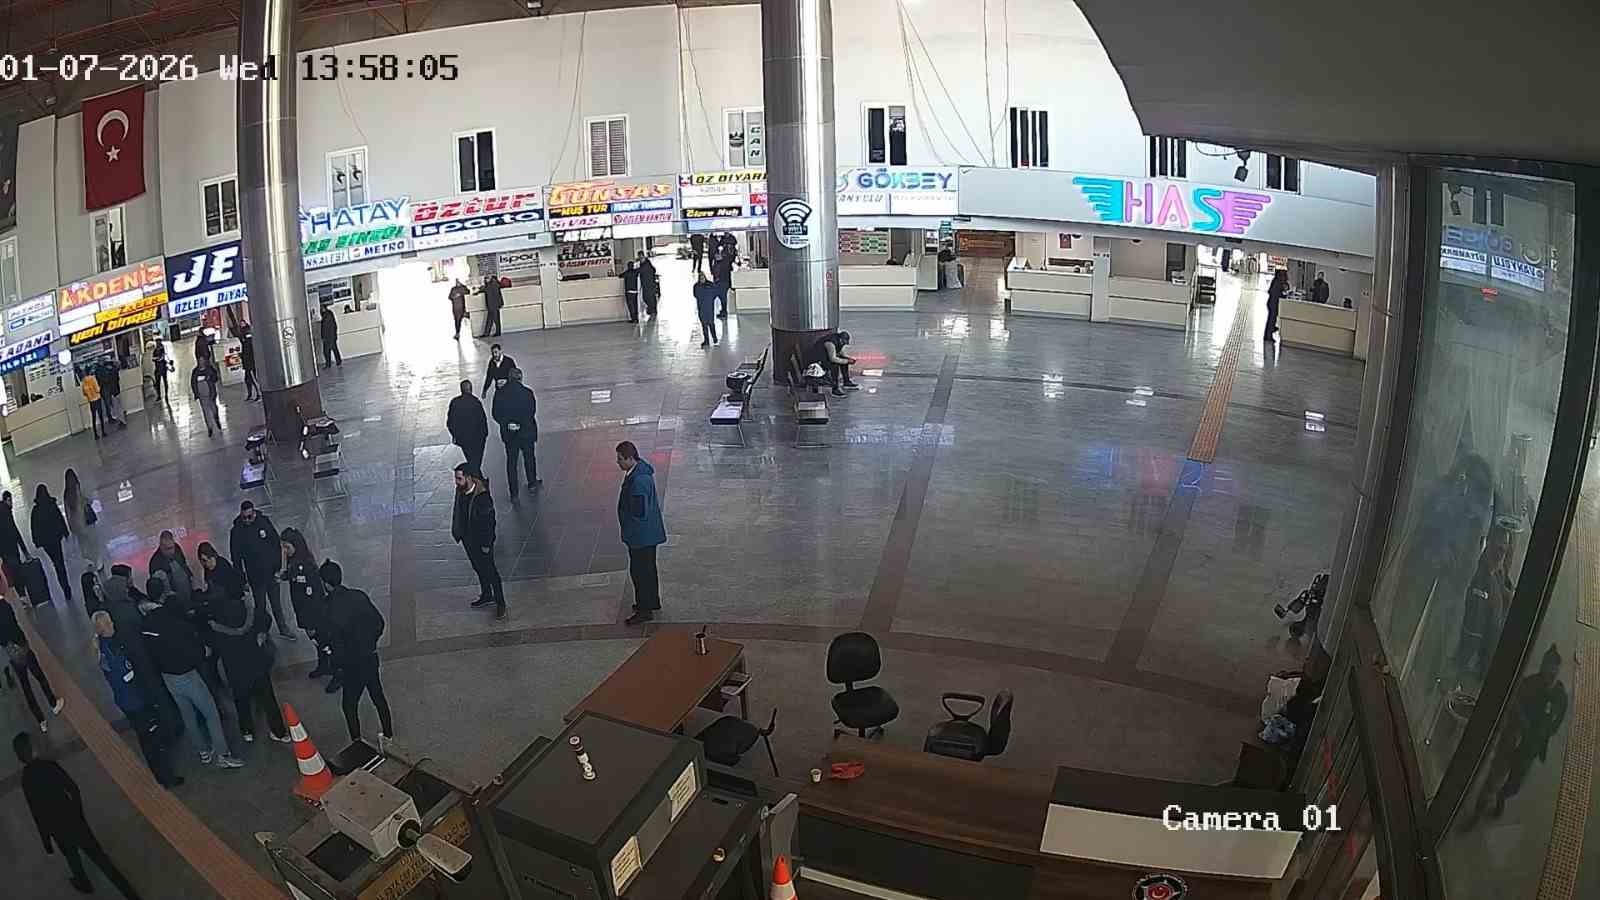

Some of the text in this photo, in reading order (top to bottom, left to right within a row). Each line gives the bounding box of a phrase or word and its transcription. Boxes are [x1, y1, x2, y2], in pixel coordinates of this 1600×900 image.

[310, 197, 408, 235] HATAY
[364, 241, 405, 256] METRO
[60, 263, 164, 311] AKDENİZ
